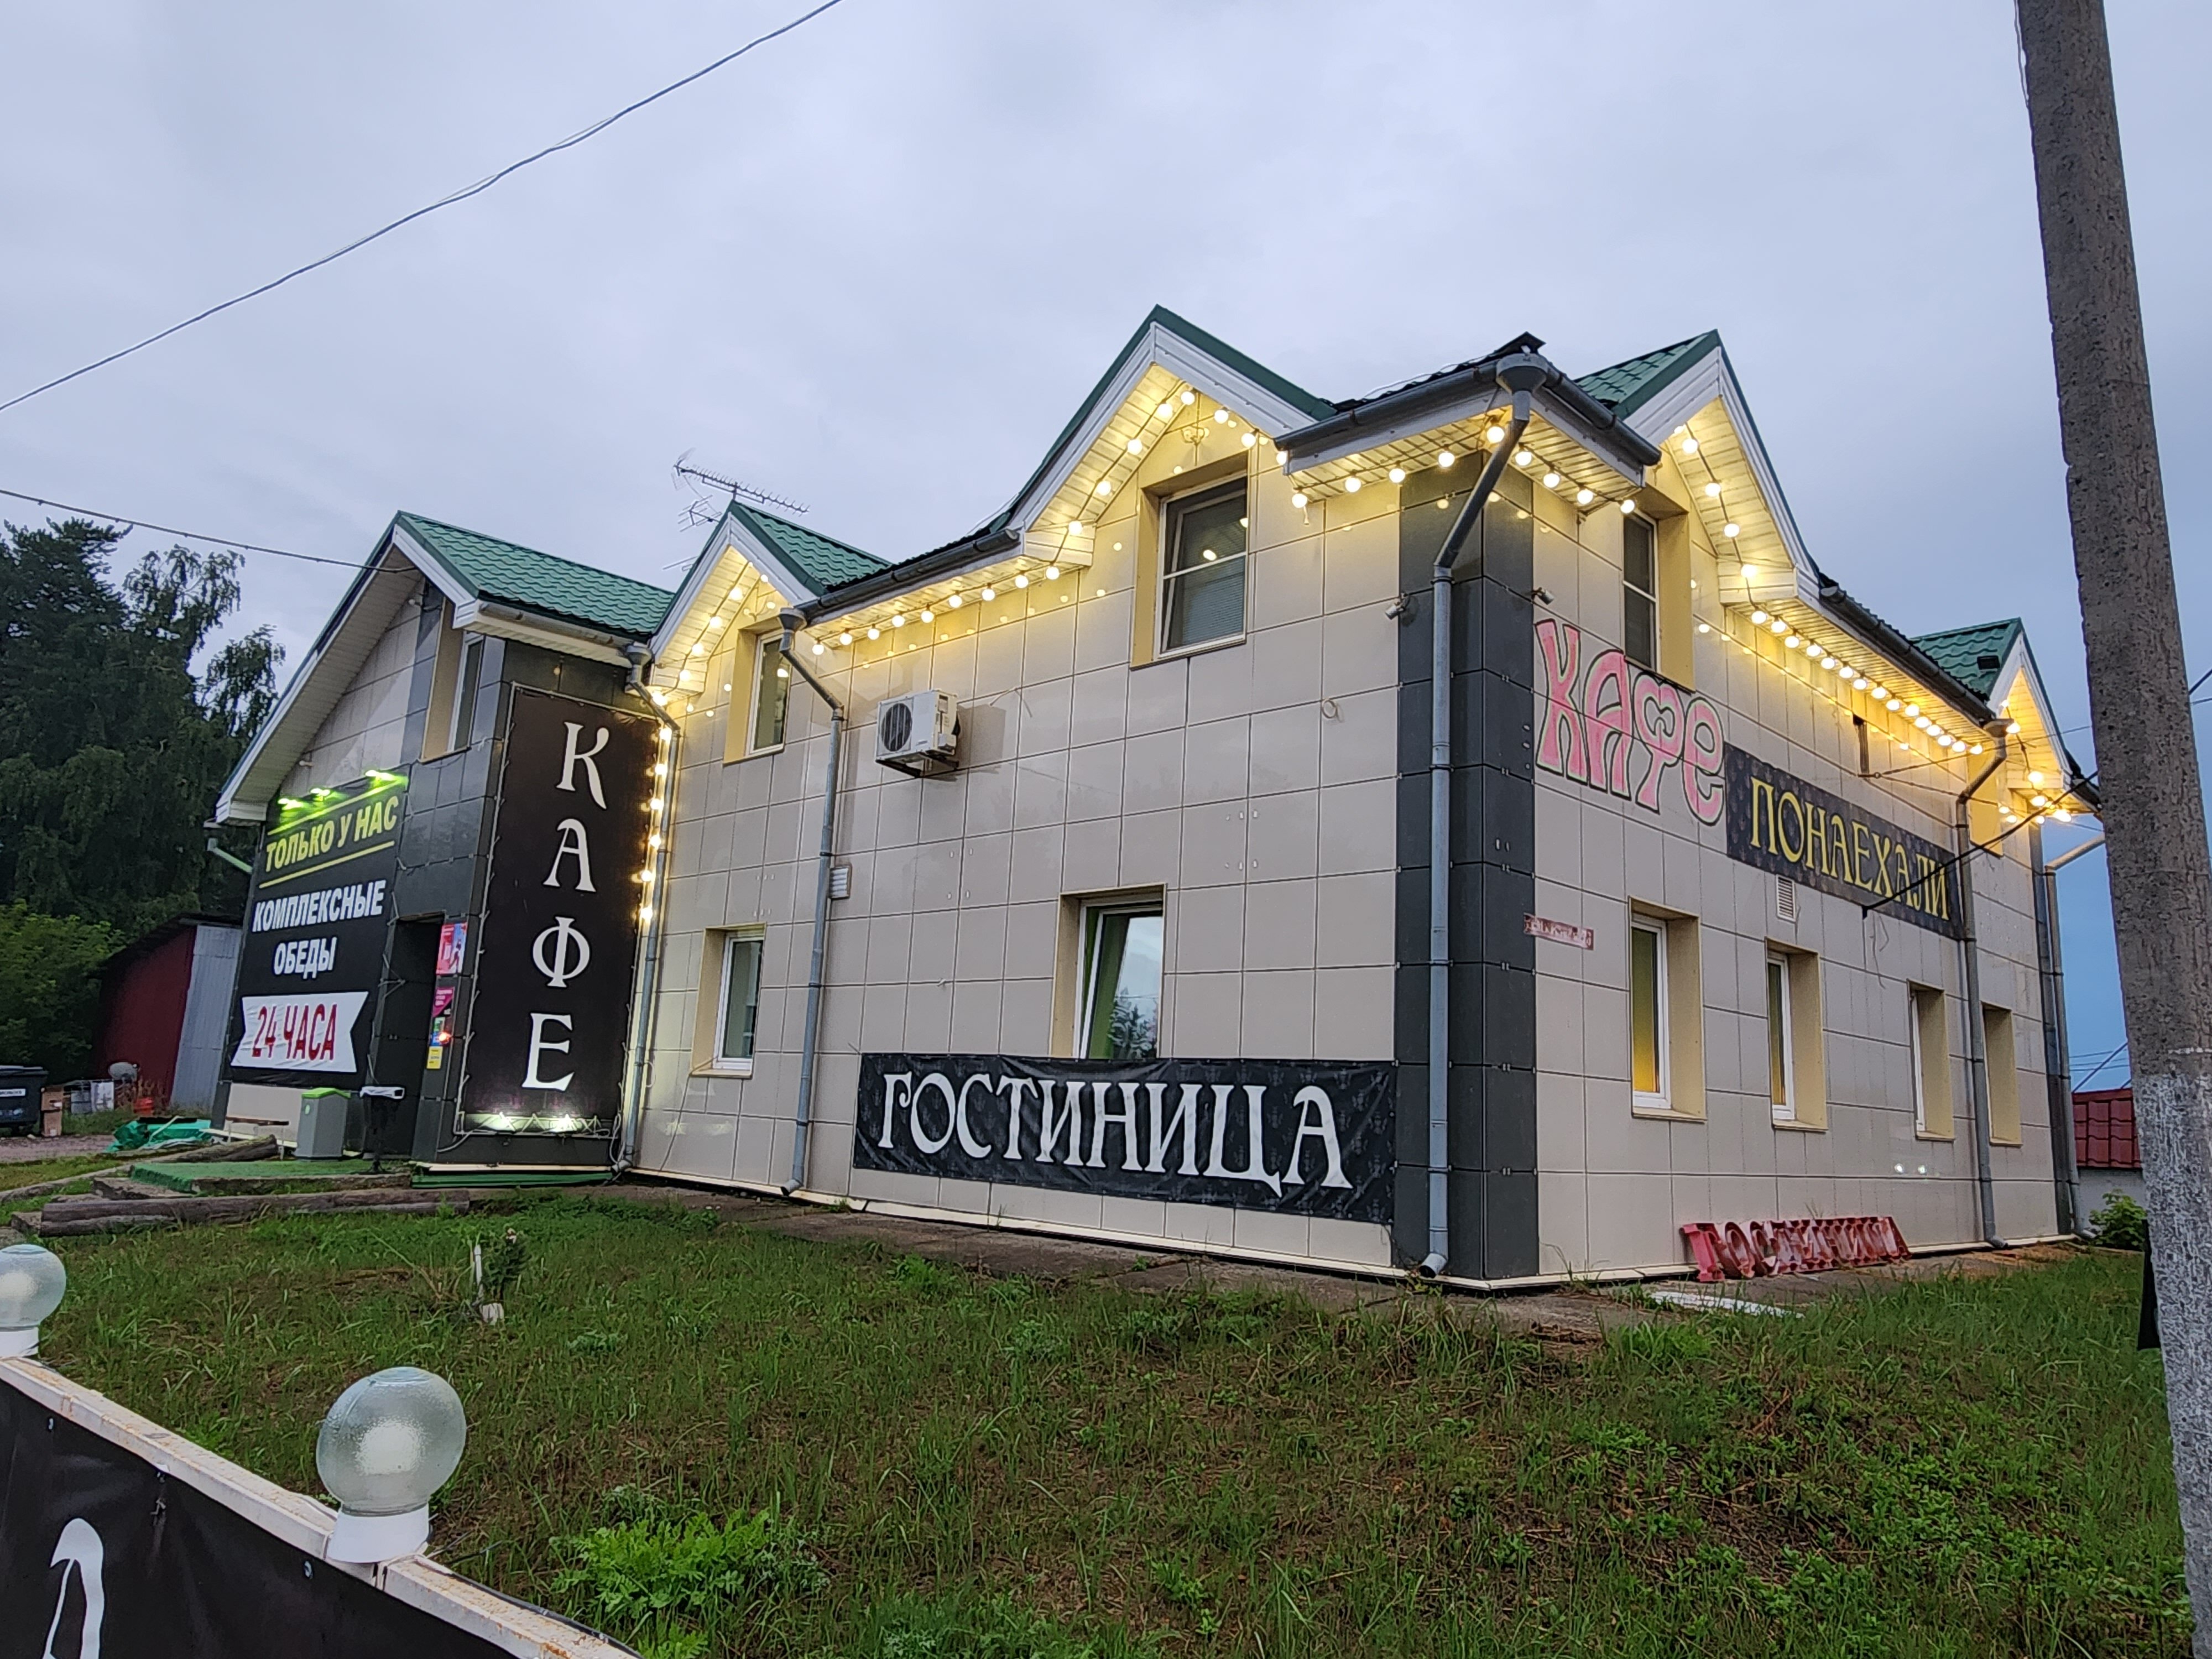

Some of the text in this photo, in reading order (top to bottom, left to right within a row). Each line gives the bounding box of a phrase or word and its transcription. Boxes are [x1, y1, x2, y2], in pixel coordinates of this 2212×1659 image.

[265, 796, 399, 872] ТОЛЬКО У НАС
[1750, 776, 1950, 921] ПОНАЕХАЛИ
[252, 880, 386, 932] КОМПЛЕКСНЫЕ
[521, 721, 610, 1092] КАФЕ
[274, 937, 337, 979] ОБЕДЫ
[252, 1003, 337, 1061] 24 ЧАСА
[878, 1072, 1353, 1198] ГОСТИНИЦА
